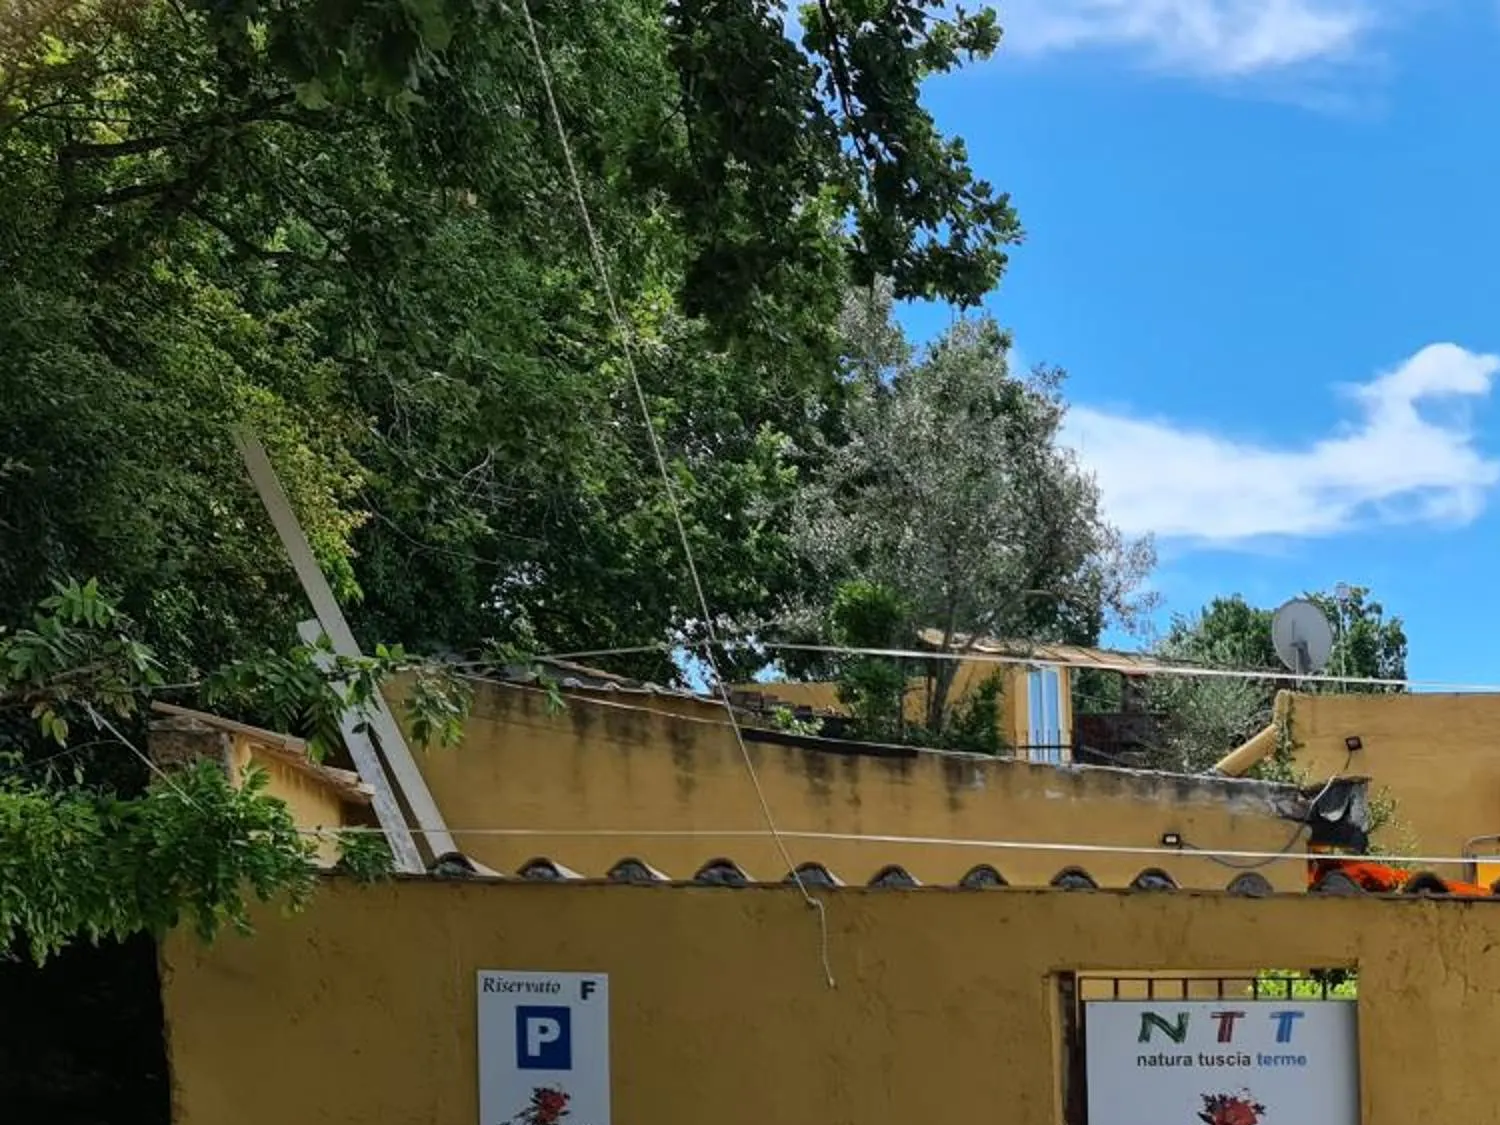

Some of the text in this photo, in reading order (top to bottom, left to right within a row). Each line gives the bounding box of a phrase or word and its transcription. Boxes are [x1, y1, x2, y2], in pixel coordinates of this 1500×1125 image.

[483, 977, 596, 1000] Riservato F
[526, 1017, 561, 1057] P
[1137, 1052, 1193, 1067] natura
[1198, 1051, 1251, 1067] tuscia
